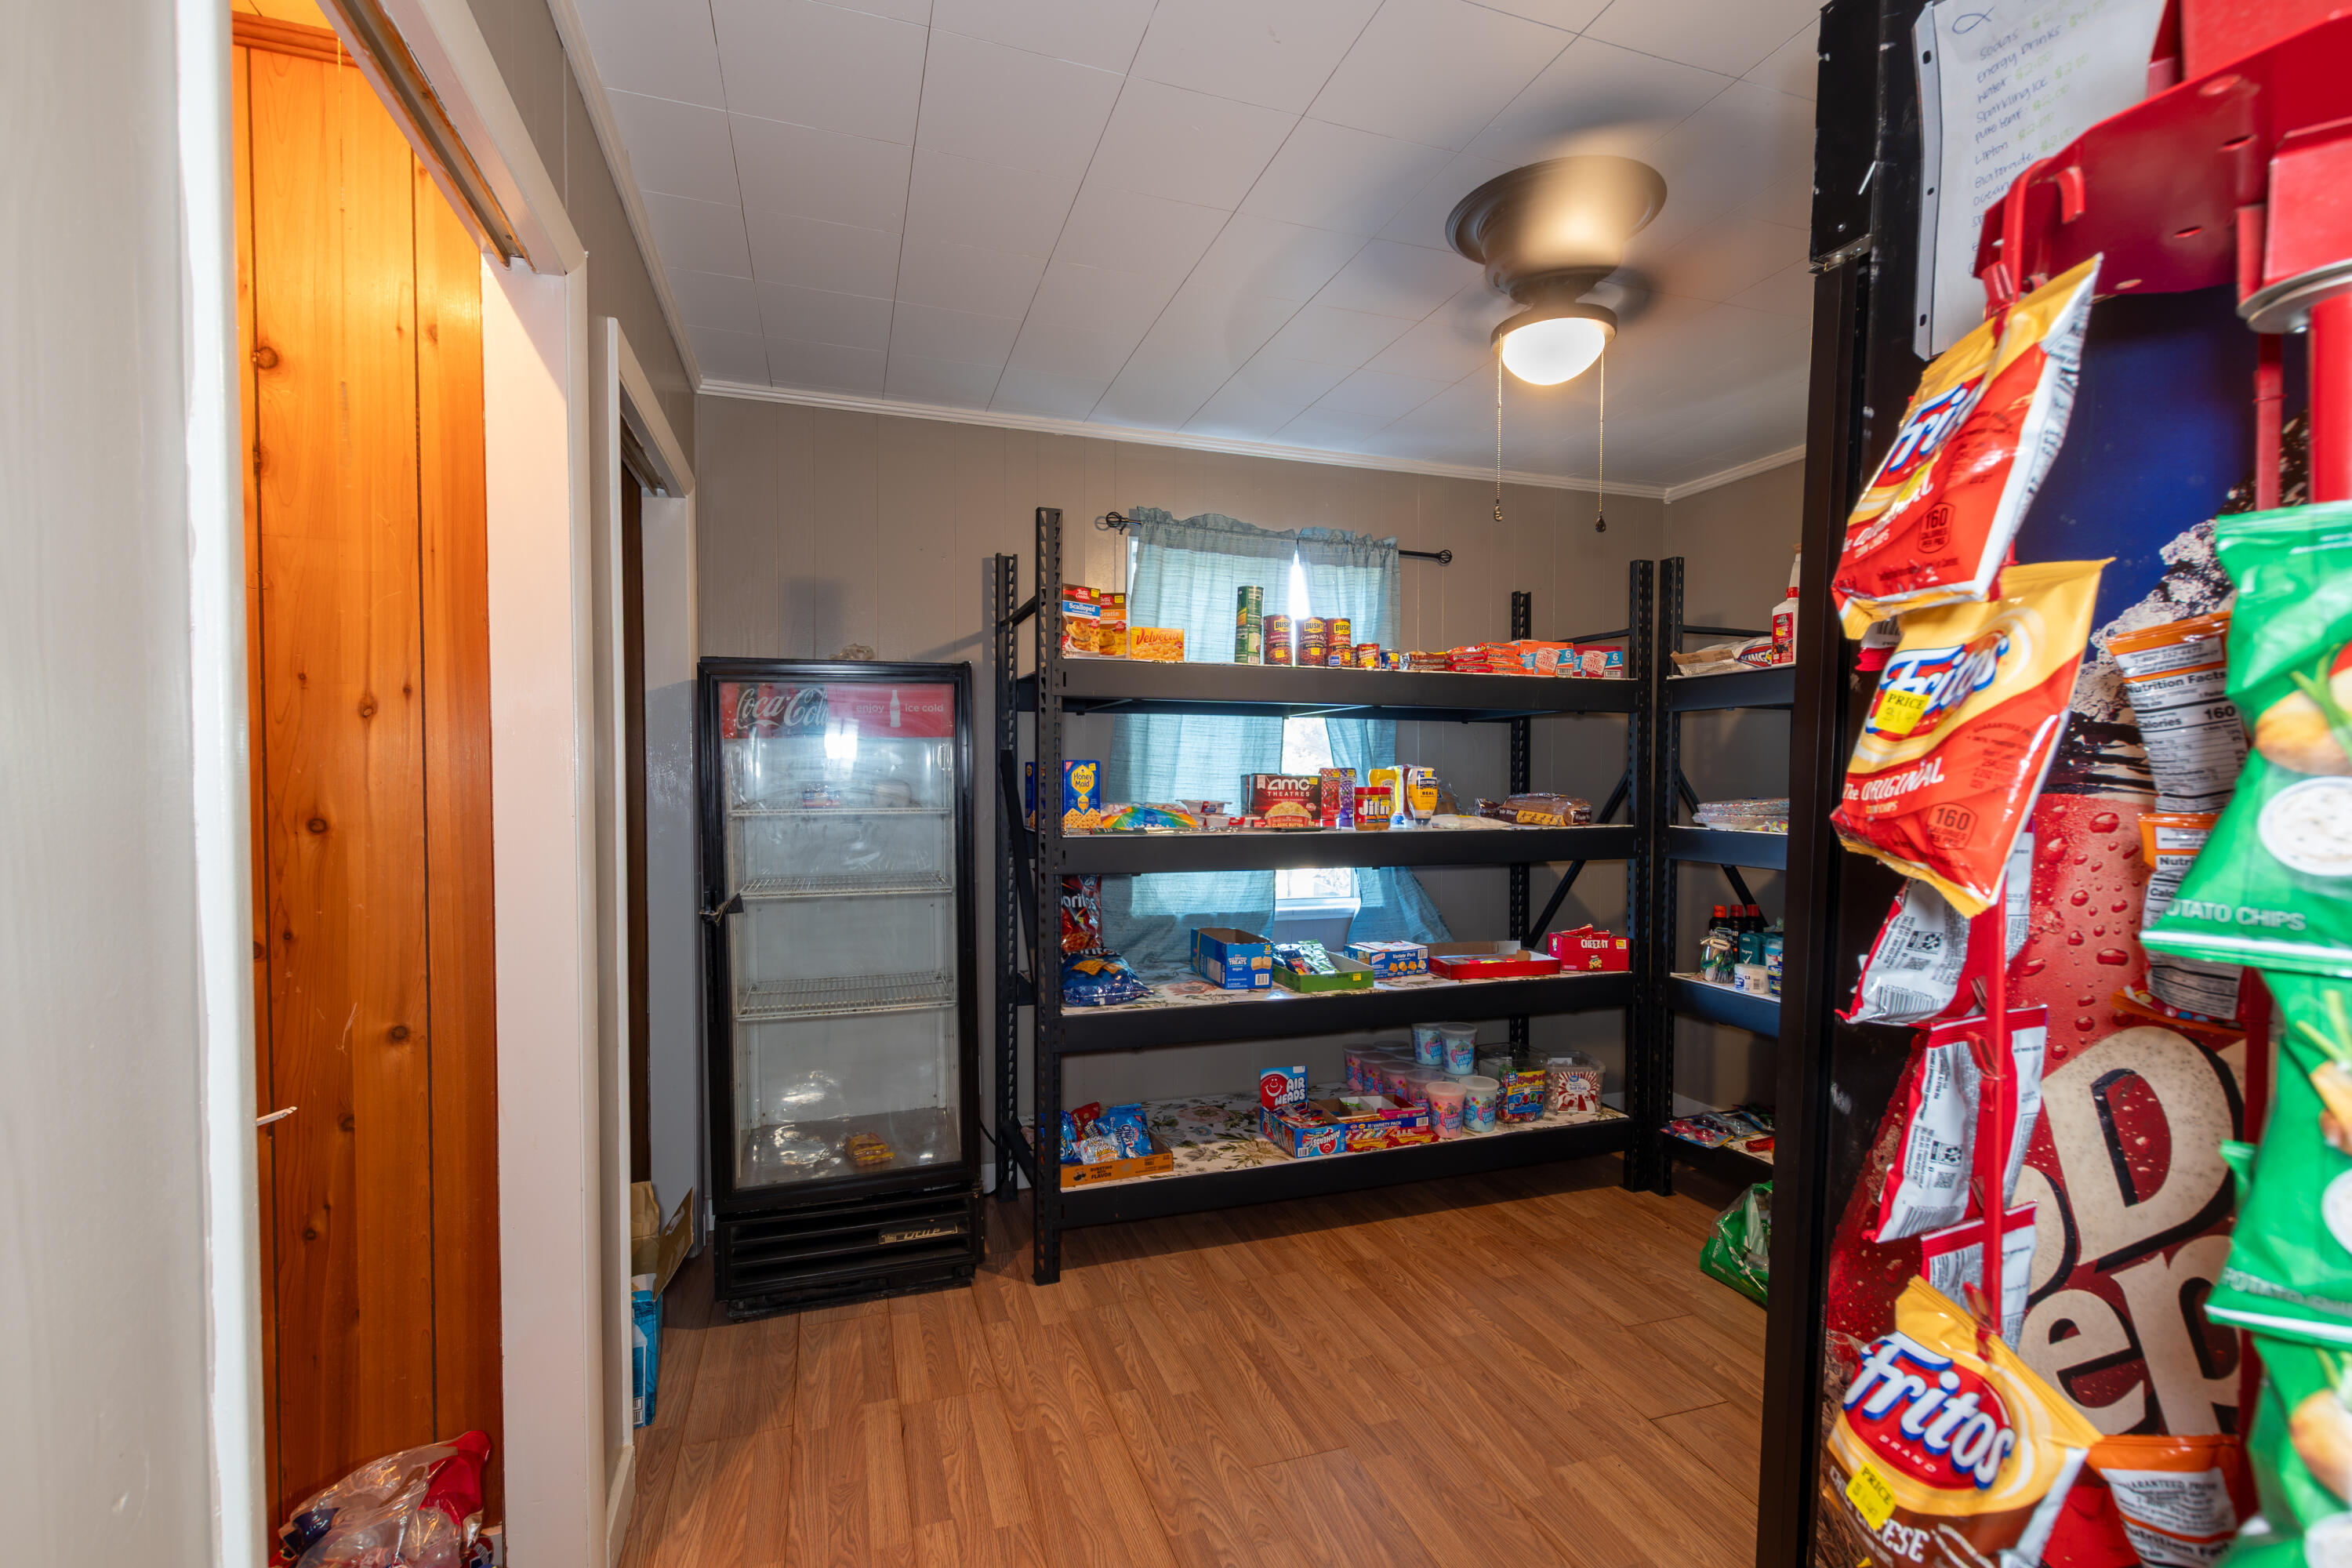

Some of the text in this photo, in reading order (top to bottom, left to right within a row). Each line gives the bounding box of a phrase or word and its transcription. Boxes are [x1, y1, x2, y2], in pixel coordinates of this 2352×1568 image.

[1926, 507, 1949, 531] 160
[1069, 602, 1095, 612] Scalloped
[1136, 628, 1180, 645] Velveeta
[1565, 650, 1571, 659] 6
[1612, 652, 1619, 661] 6
[855, 702, 884, 714] enjoy
[905, 703, 920, 713] ice
[922, 702, 944, 713] cold
[1887, 693, 1926, 710] PRICE
[2204, 705, 2235, 720] 160
[1073, 771, 1093, 782] Honey
[1861, 757, 1944, 800] ORIGINAL
[1936, 808, 1970, 830] 160
[2159, 857, 2196, 866] Nutri
[2235, 906, 2307, 931] CHIPS
[1286, 1076, 1305, 1093] AIR
[1274, 1088, 1306, 1106] HEADS
[1842, 1330, 2016, 1490] Fritos
[1878, 1434, 1936, 1474] BRAND
[1861, 1467, 1893, 1506] PRICE
